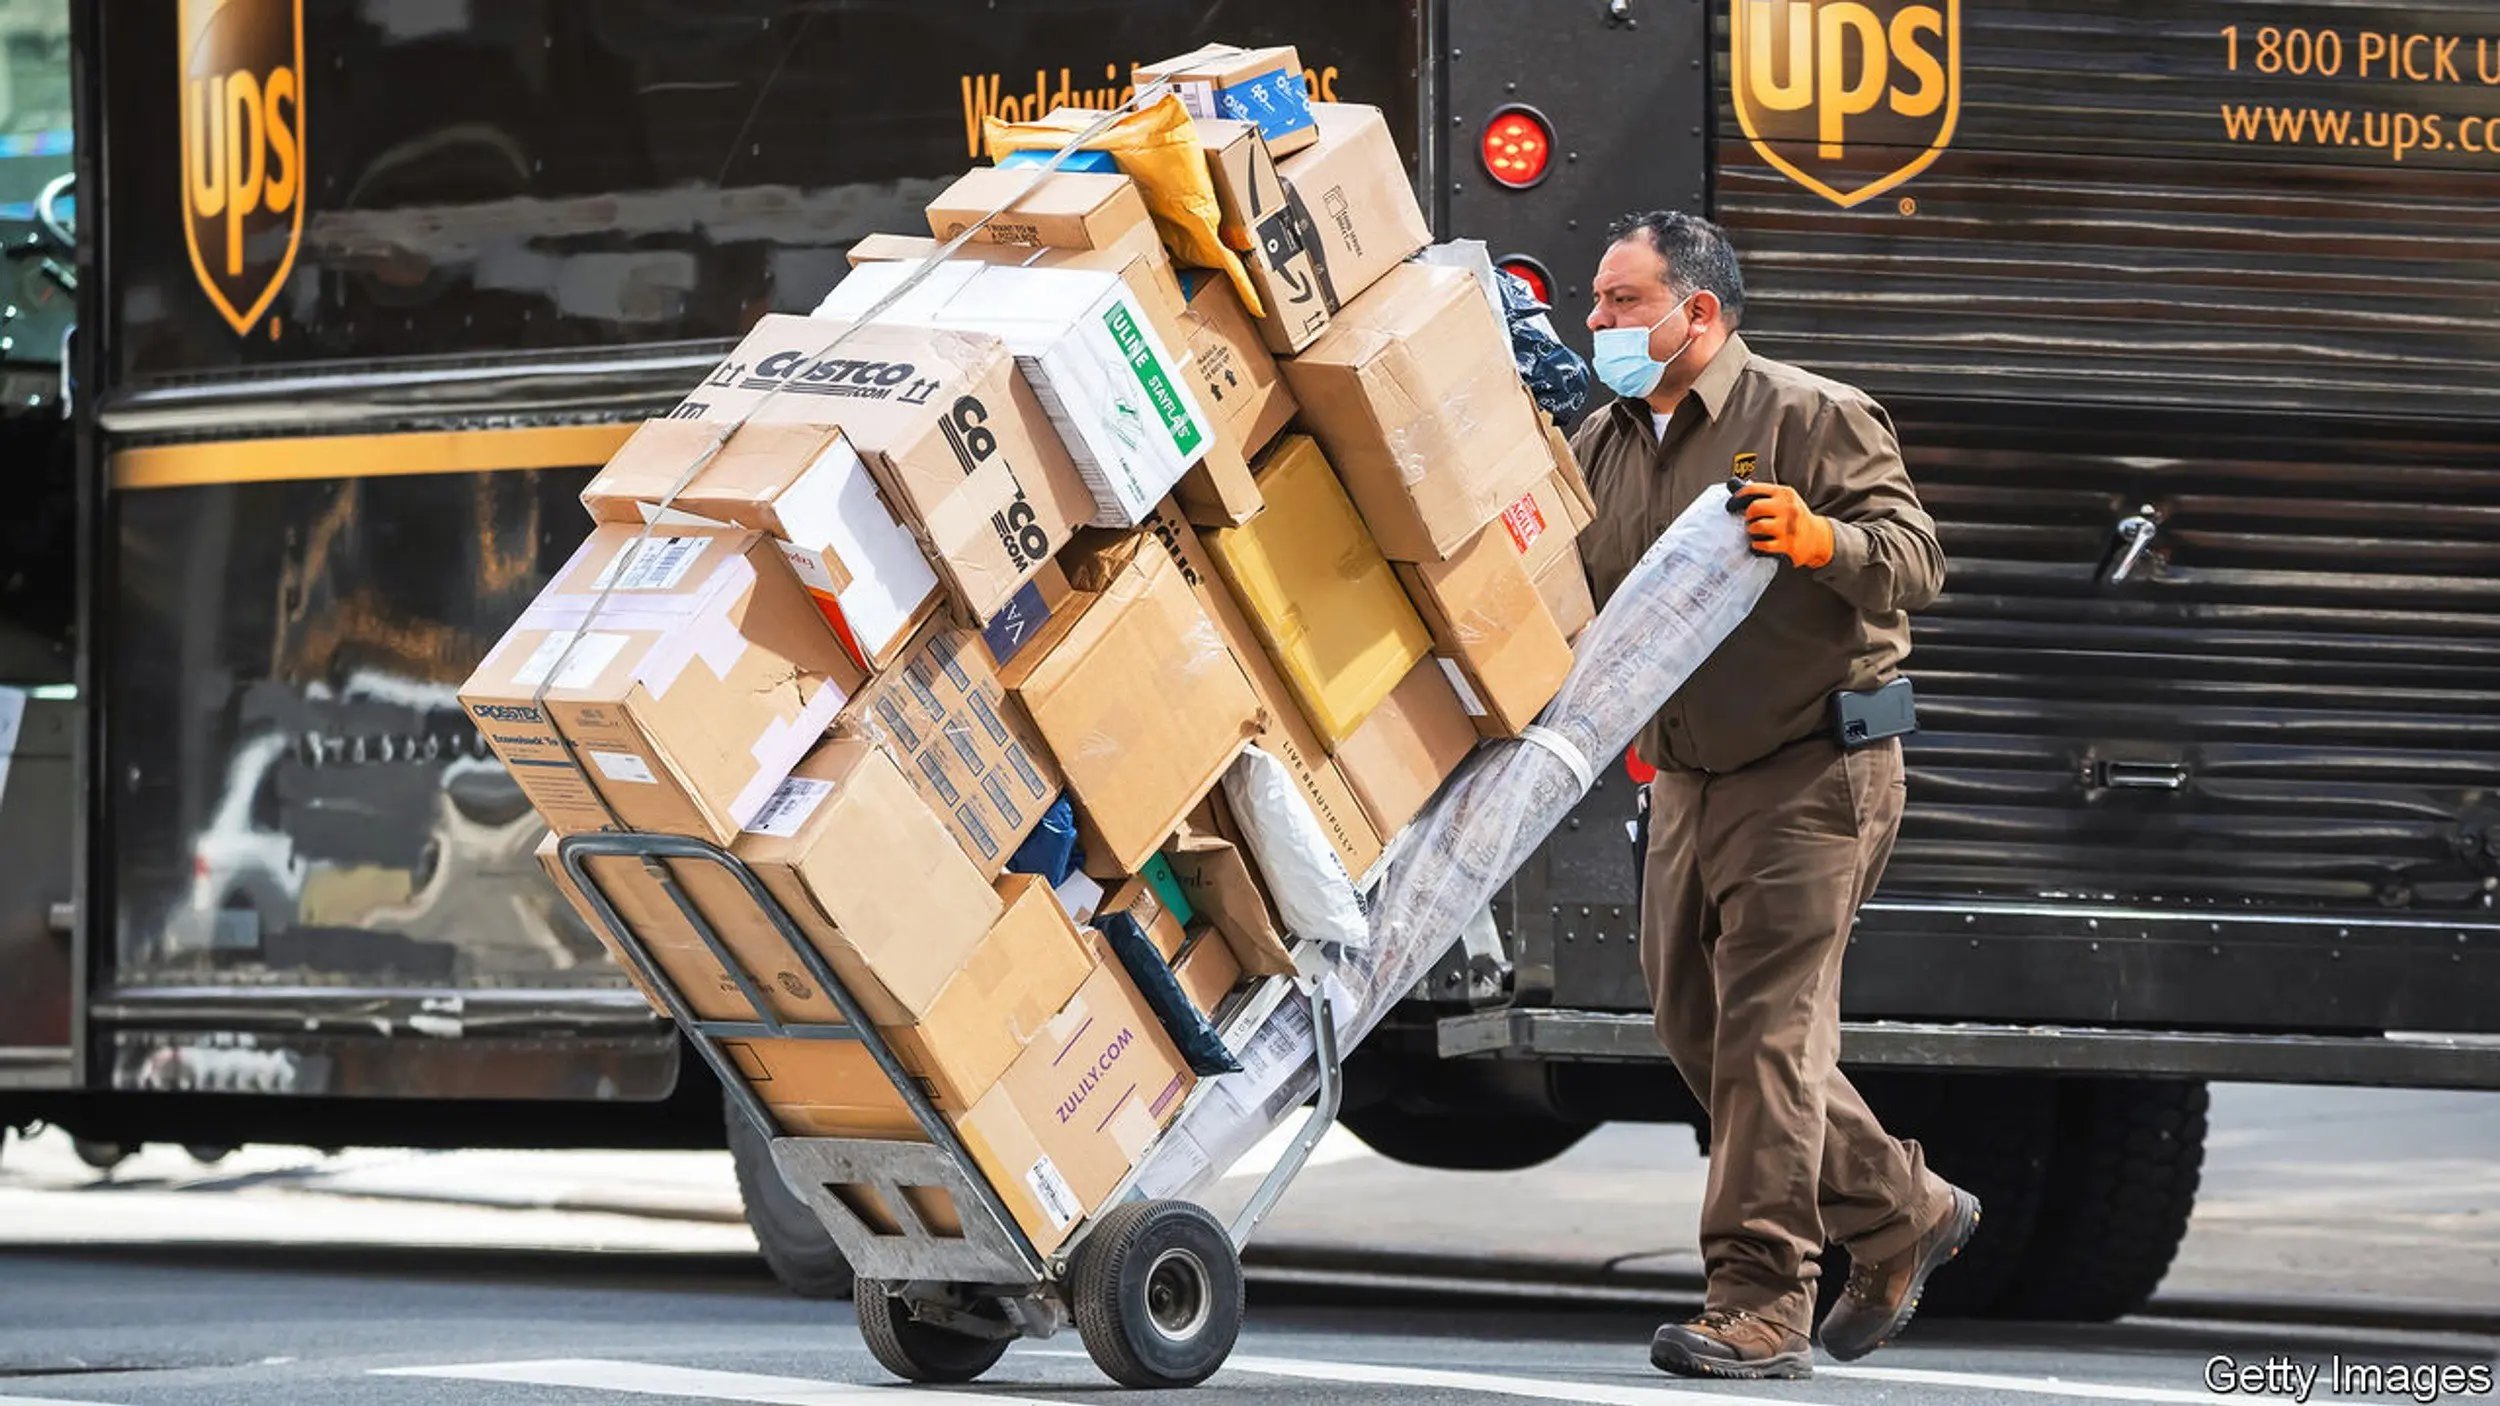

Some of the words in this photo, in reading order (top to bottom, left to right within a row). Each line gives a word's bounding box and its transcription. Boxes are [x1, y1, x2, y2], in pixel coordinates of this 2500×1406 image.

[1748, 1, 1946, 160] ups
[2221, 25, 2238, 71] 1
[2256, 27, 2342, 77] 800
[2359, 32, 2461, 83] PICK
[187, 64, 296, 276] ups
[1112, 313, 1149, 368] ULINE
[953, 395, 1050, 560] COCO
[1734, 461, 1755, 479] ups
[1282, 741, 1303, 770] LIVE
[1302, 772, 1353, 853] BEAUTIFULLY
[1056, 1027, 1134, 1124] ZULILY.COM
